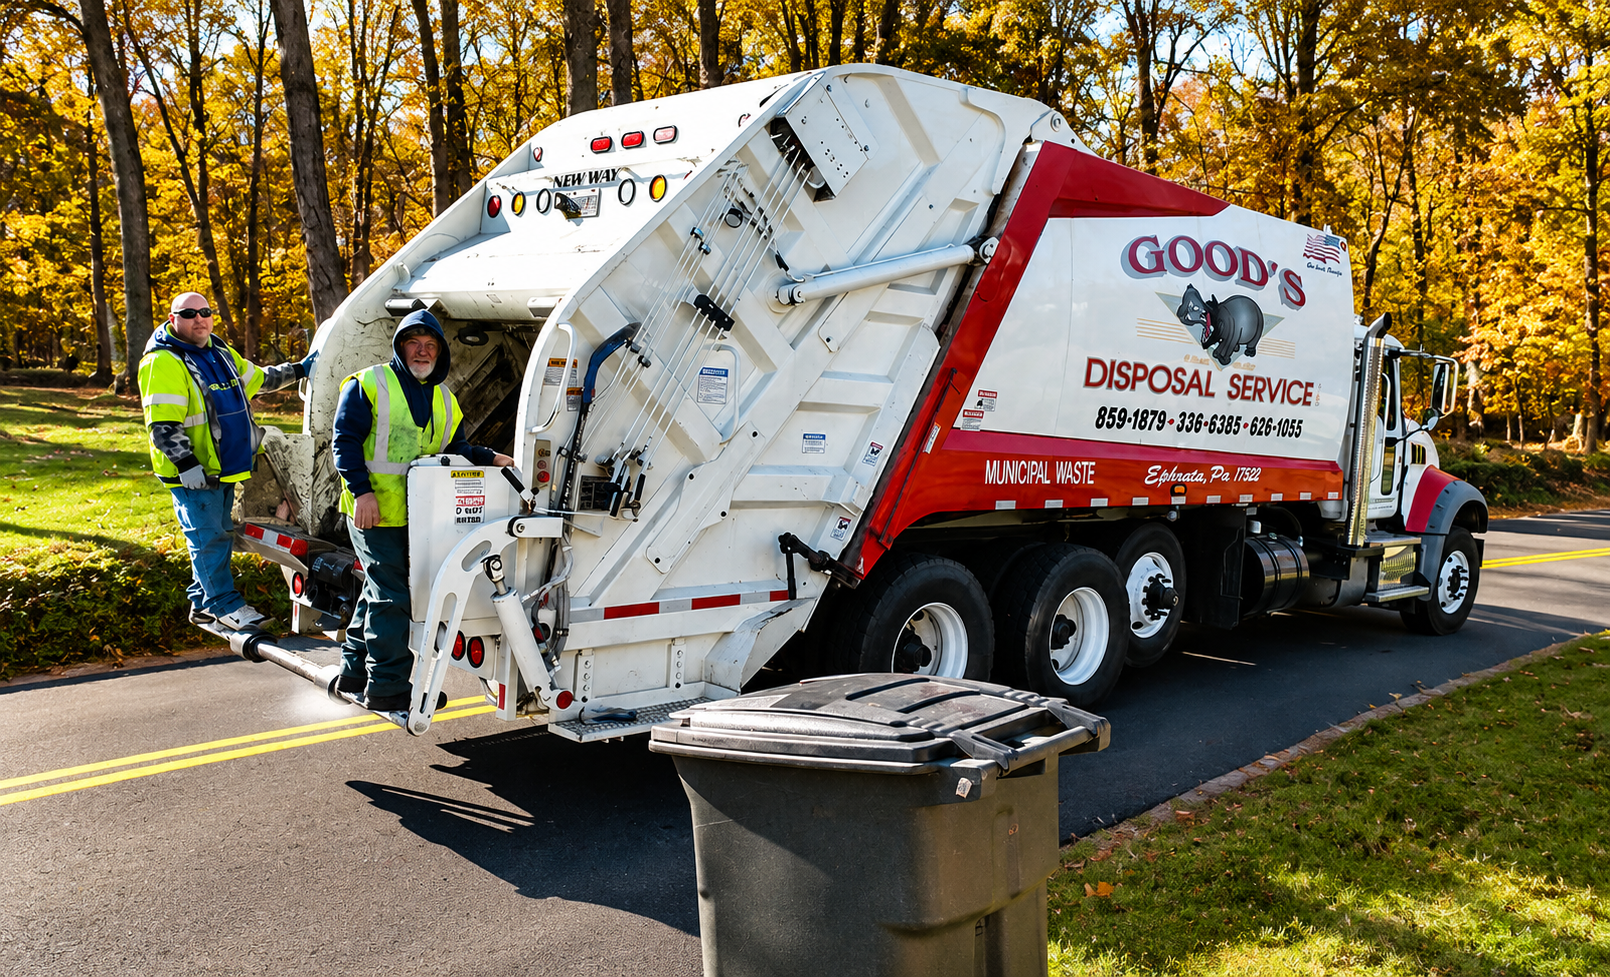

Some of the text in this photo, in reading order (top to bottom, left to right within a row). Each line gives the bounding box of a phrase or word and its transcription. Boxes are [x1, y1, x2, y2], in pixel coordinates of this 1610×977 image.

[553, 167, 621, 188] NEW WAY
[1121, 235, 1306, 311] GOOD'S
[1083, 356, 1216, 398] DISPOSAL
[1227, 373, 1315, 407] SERVICE
[985, 459, 1096, 485] MUNICIPAL WASTE
[1144, 464, 1262, 488] Ephrata, Pa 17522
